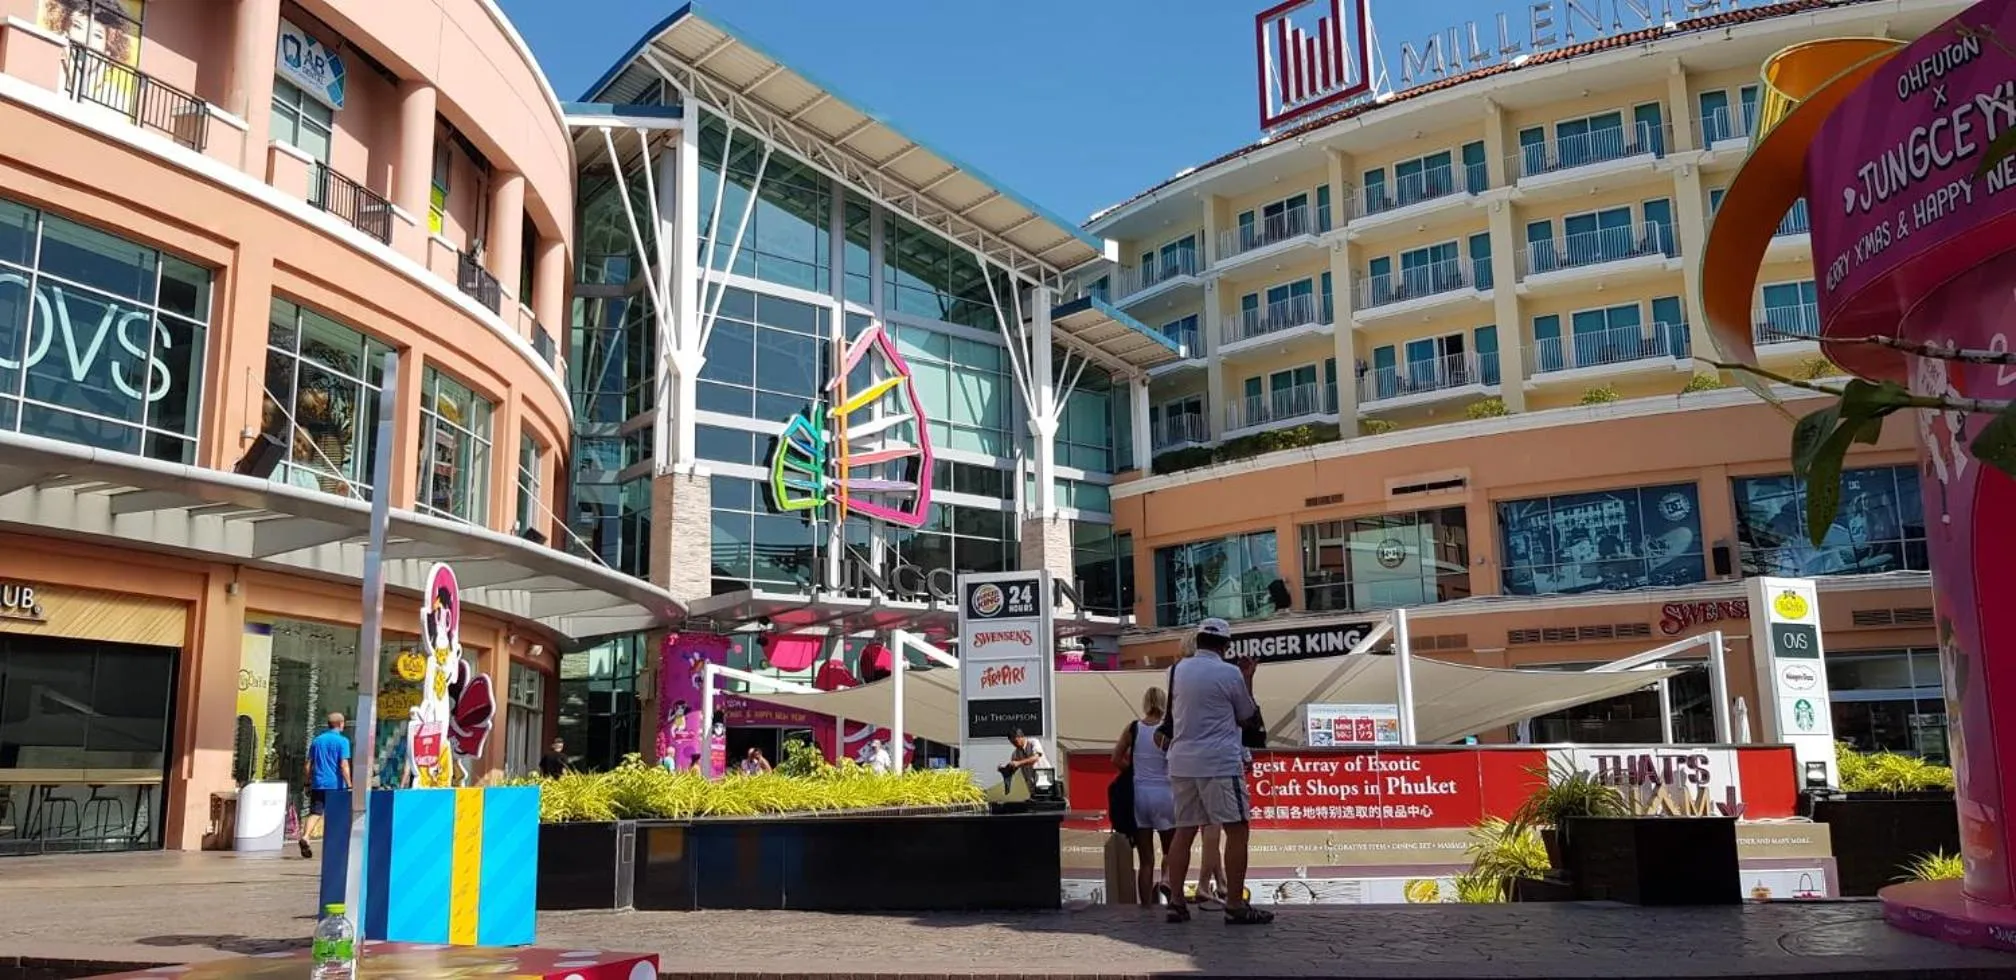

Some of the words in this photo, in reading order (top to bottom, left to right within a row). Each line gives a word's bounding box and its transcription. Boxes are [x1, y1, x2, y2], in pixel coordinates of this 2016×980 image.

[1402, 0, 1741, 83] MILLENN
[1897, 35, 1980, 98] OHFUTON
[1855, 220, 1891, 266] X'MAS
[1897, 210, 1909, 239] &
[1913, 173, 1974, 229] HAPPY
[0, 273, 171, 402] OVS
[1009, 584, 1032, 605] 24
[1009, 604, 1033, 613] HOURS
[1224, 635, 1301, 659] BURGER
[1305, 630, 1361, 653] KING
[1783, 632, 1808, 649] OVS
[972, 713, 988, 724] JIM
[990, 712, 1037, 722] THOMPSON
[1291, 756, 1339, 776] Array
[1344, 755, 1364, 772] of
[1367, 755, 1421, 772] Exotic
[1590, 754, 1711, 786] THAT'S
[1256, 778, 1302, 797] Craft
[1306, 778, 1359, 800] Shops
[1364, 778, 1381, 795] in
[1386, 775, 1458, 795] Phuket
